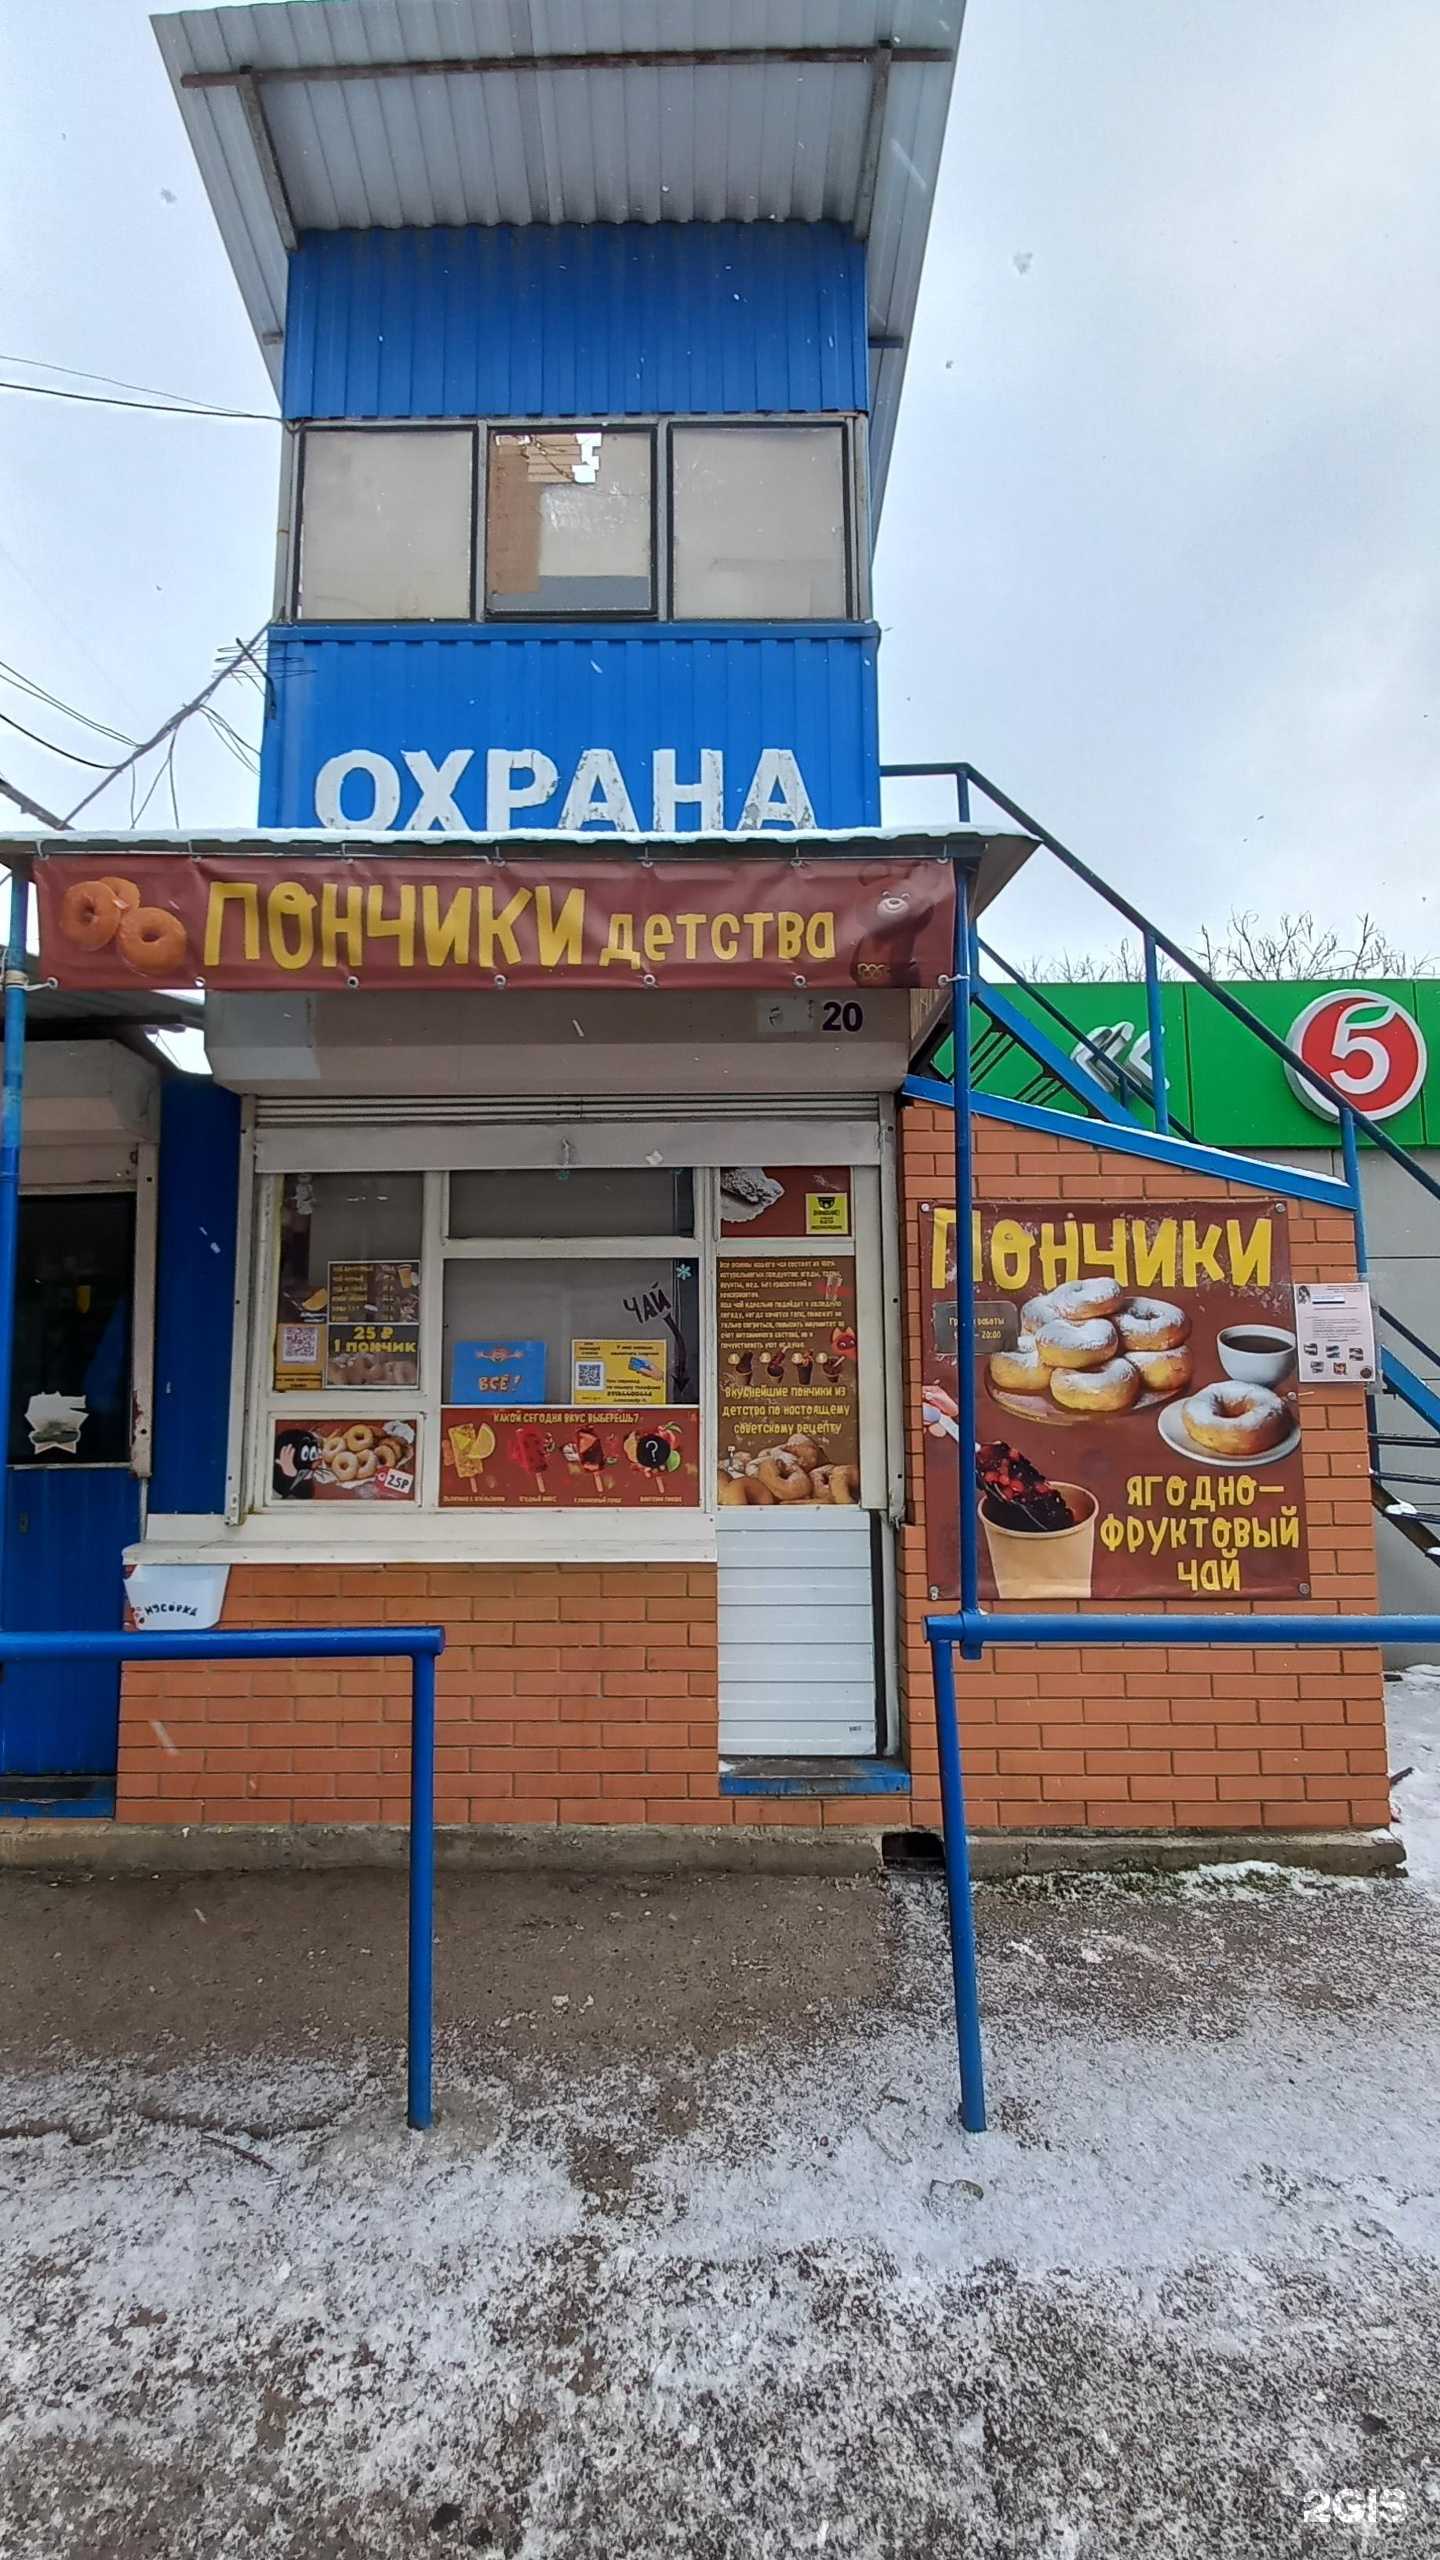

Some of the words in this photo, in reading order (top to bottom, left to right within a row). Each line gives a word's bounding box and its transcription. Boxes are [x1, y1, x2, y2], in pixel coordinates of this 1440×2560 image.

[314, 748, 818, 831] ОХРАНА
[599, 911, 837, 970] детства
[822, 1001, 864, 1033] 20
[623, 1281, 672, 1324] ЧАЙ
[334, 1340, 341, 1353] 1
[353, 1326, 376, 1340] 25
[493, 1411, 522, 1423] КАКОЙ
[523, 1412, 562, 1424] СЕГОДНЯ
[563, 1412, 586, 1424] ВКУС
